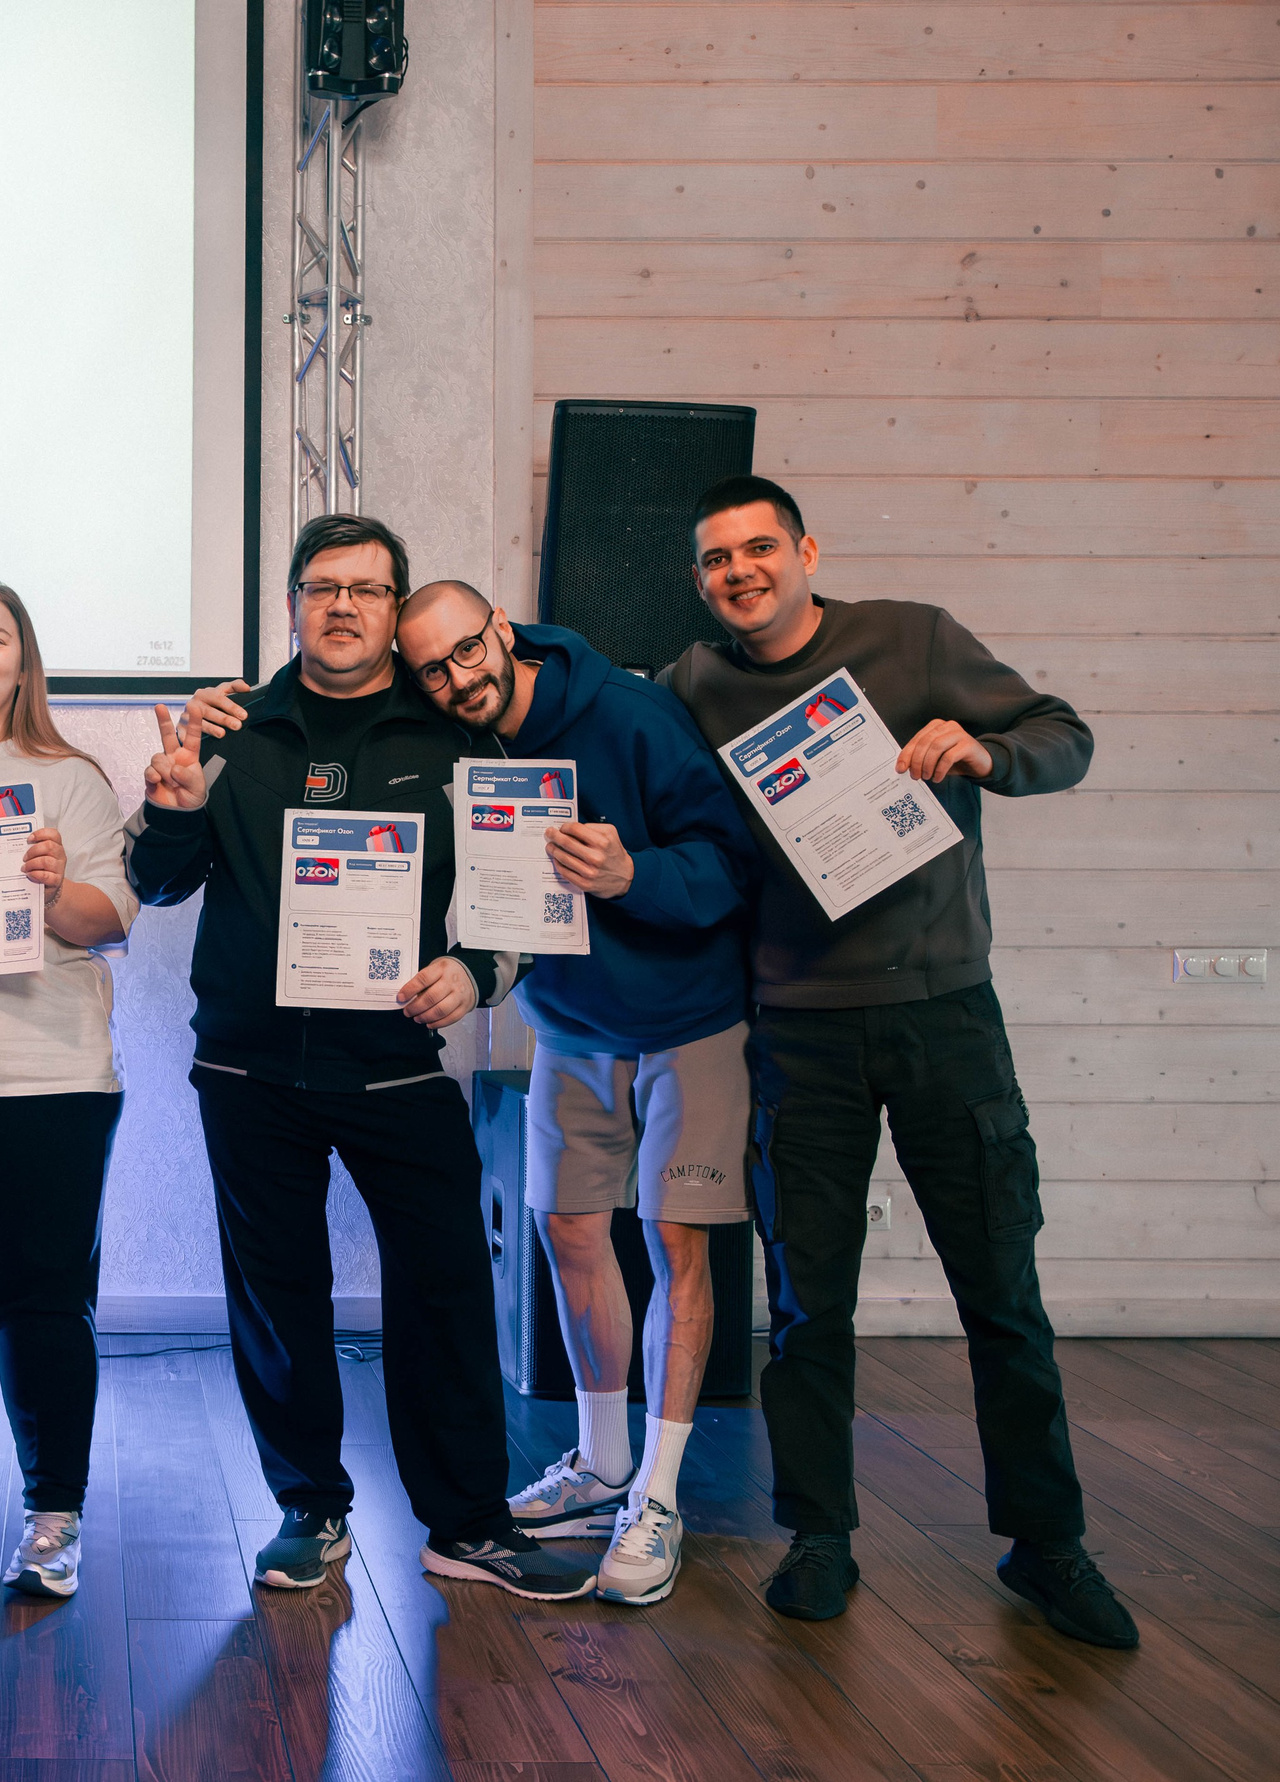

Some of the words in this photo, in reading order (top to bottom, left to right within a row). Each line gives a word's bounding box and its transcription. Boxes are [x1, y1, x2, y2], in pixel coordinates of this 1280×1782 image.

[738, 736, 776, 762] Сертификат
[775, 724, 793, 738] Ozon
[472, 774, 511, 783] Сертификат
[511, 775, 529, 783] Ozon
[763, 766, 806, 798] OZON
[472, 812, 514, 825] OZON
[296, 826, 336, 835] Сертификат
[337, 827, 355, 835] Ozon
[296, 866, 338, 878] OZON
[660, 1164, 727, 1186] CAMPTOWN
